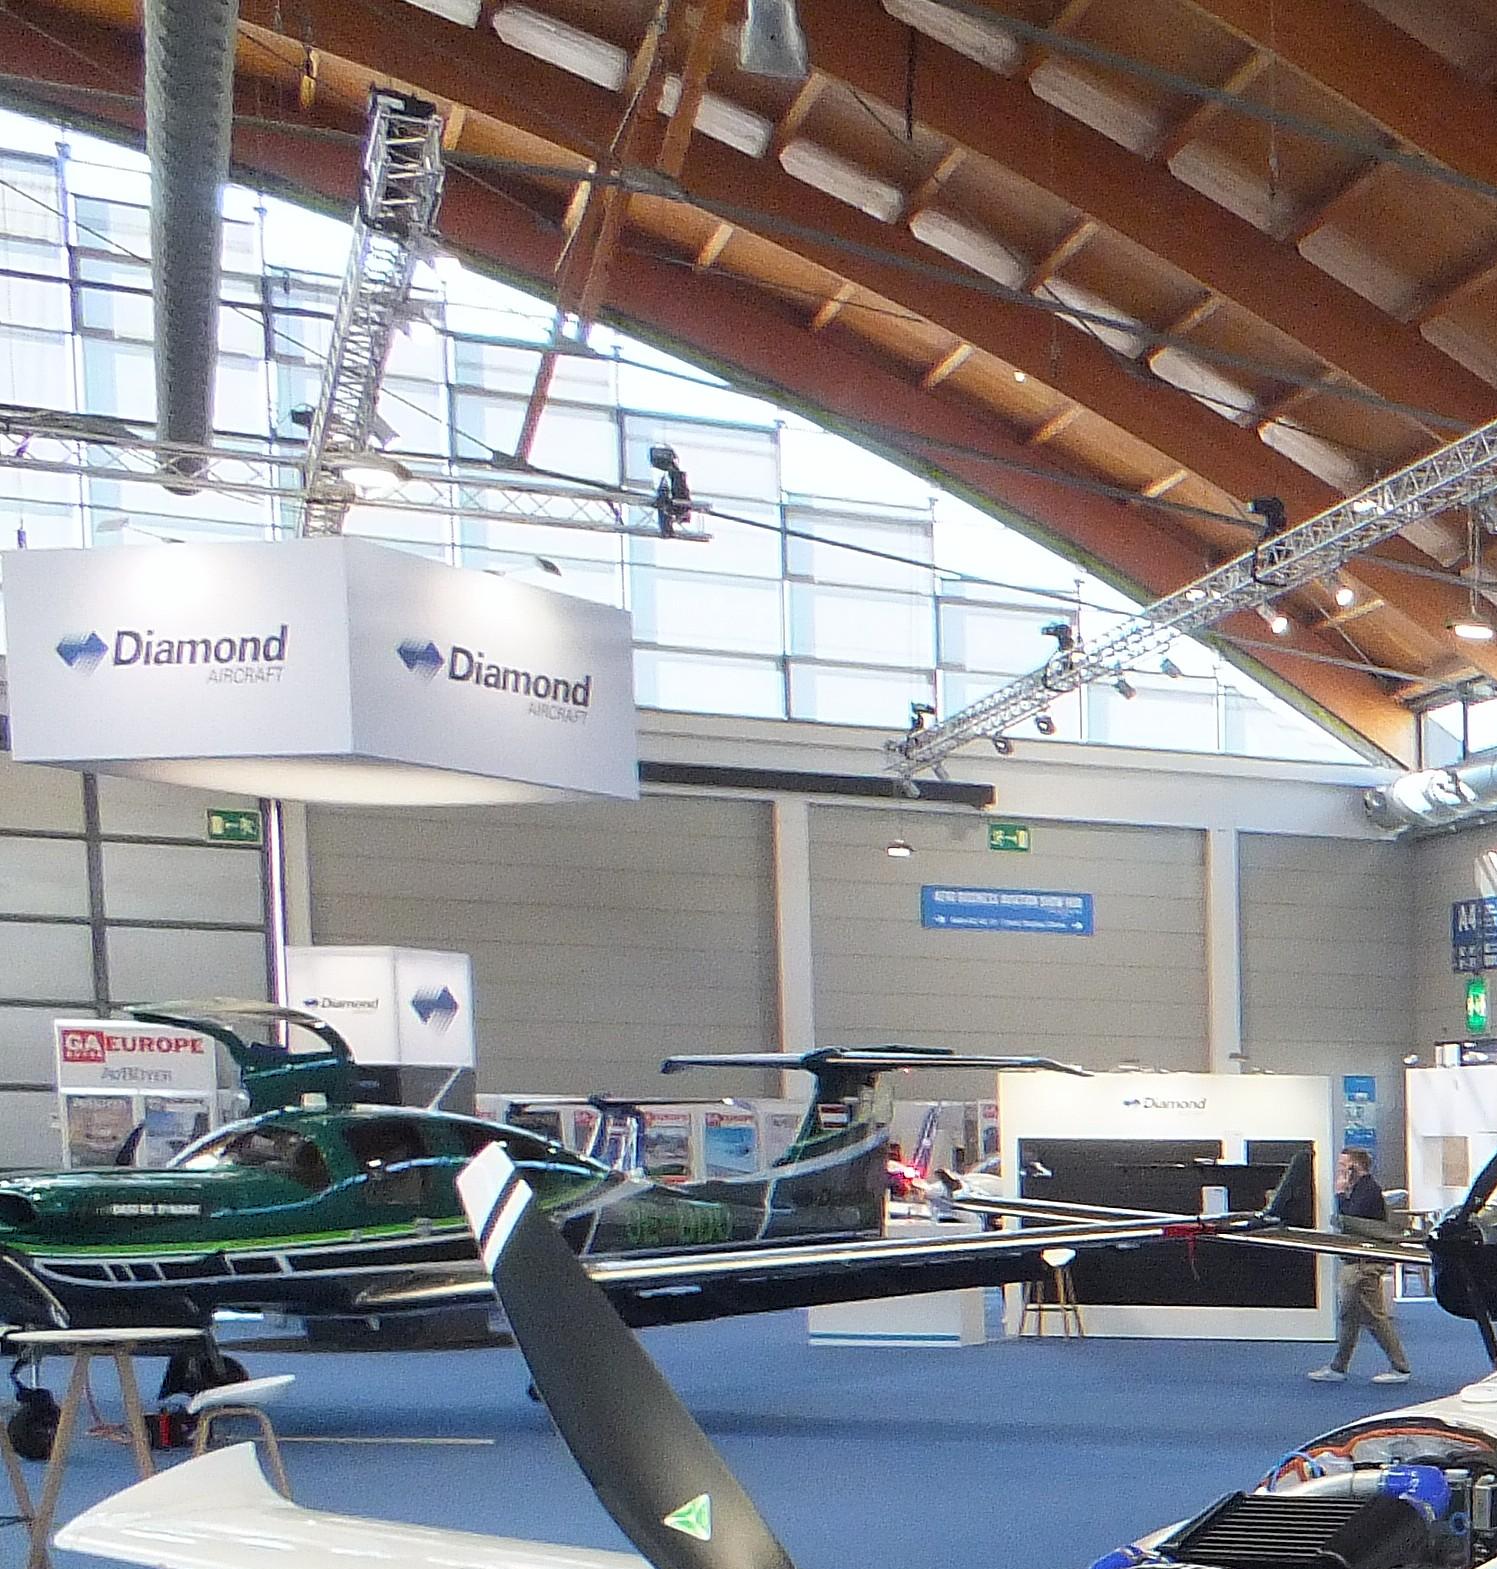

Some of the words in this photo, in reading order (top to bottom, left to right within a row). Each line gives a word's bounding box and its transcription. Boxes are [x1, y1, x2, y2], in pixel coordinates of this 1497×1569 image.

[112, 624, 289, 666] Diamond
[206, 666, 284, 684] AIRCRAFT
[448, 645, 592, 707] Diamond
[528, 702, 589, 725] AIRCRAFT
[321, 998, 379, 1009] Diamond
[105, 1036, 205, 1054] EUROPE
[1143, 1097, 1207, 1109] Diamond
